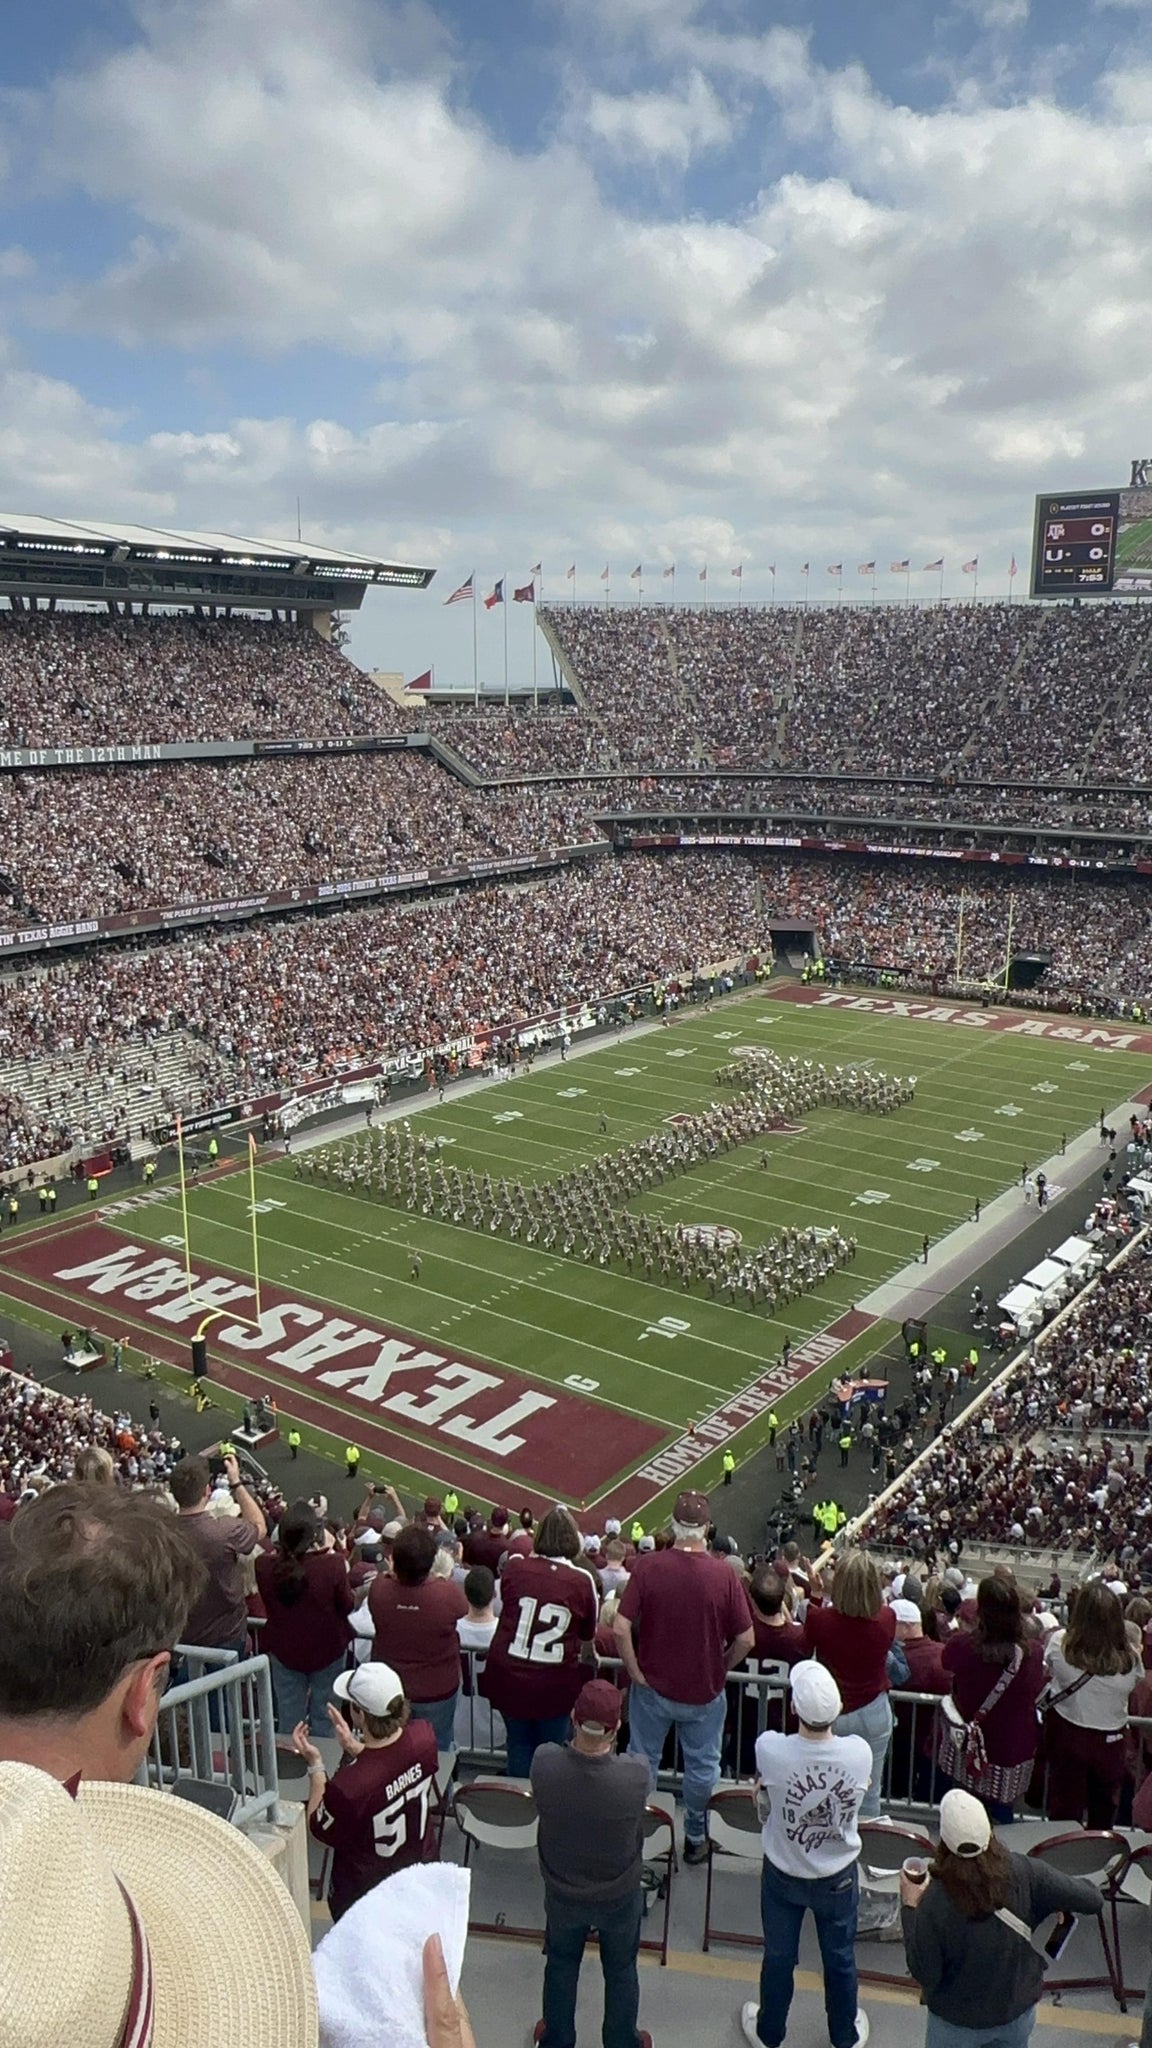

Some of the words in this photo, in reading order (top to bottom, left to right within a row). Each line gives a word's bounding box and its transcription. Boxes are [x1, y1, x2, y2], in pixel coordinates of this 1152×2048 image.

[29, 750, 47, 765] OF
[55, 748, 84, 763] THE
[91, 747, 126, 762] 12TH
[132, 745, 161, 759] MAN
[18, 929, 48, 943] TEXAS
[49, 925, 75, 938] AGGIE
[76, 921, 99, 935] BAND
[812, 992, 1000, 1027] TEXAS
[1004, 1019, 1142, 1049] A&M
[53, 1245, 259, 1325] A&M
[646, 1316, 691, 1339] 10
[218, 1302, 559, 1456] TEXAS
[637, 1435, 703, 1487] HOME
[700, 1415, 737, 1442] OF
[722, 1386, 780, 1419] THE
[793, 1333, 847, 1366] MAN
[508, 1596, 572, 1664] 12
[385, 1763, 423, 1801] BARNES
[785, 1772, 827, 1807] TEXAS
[829, 1779, 857, 1811] A&M
[373, 1774, 433, 1858] 57
[782, 1806, 796, 1825] 18
